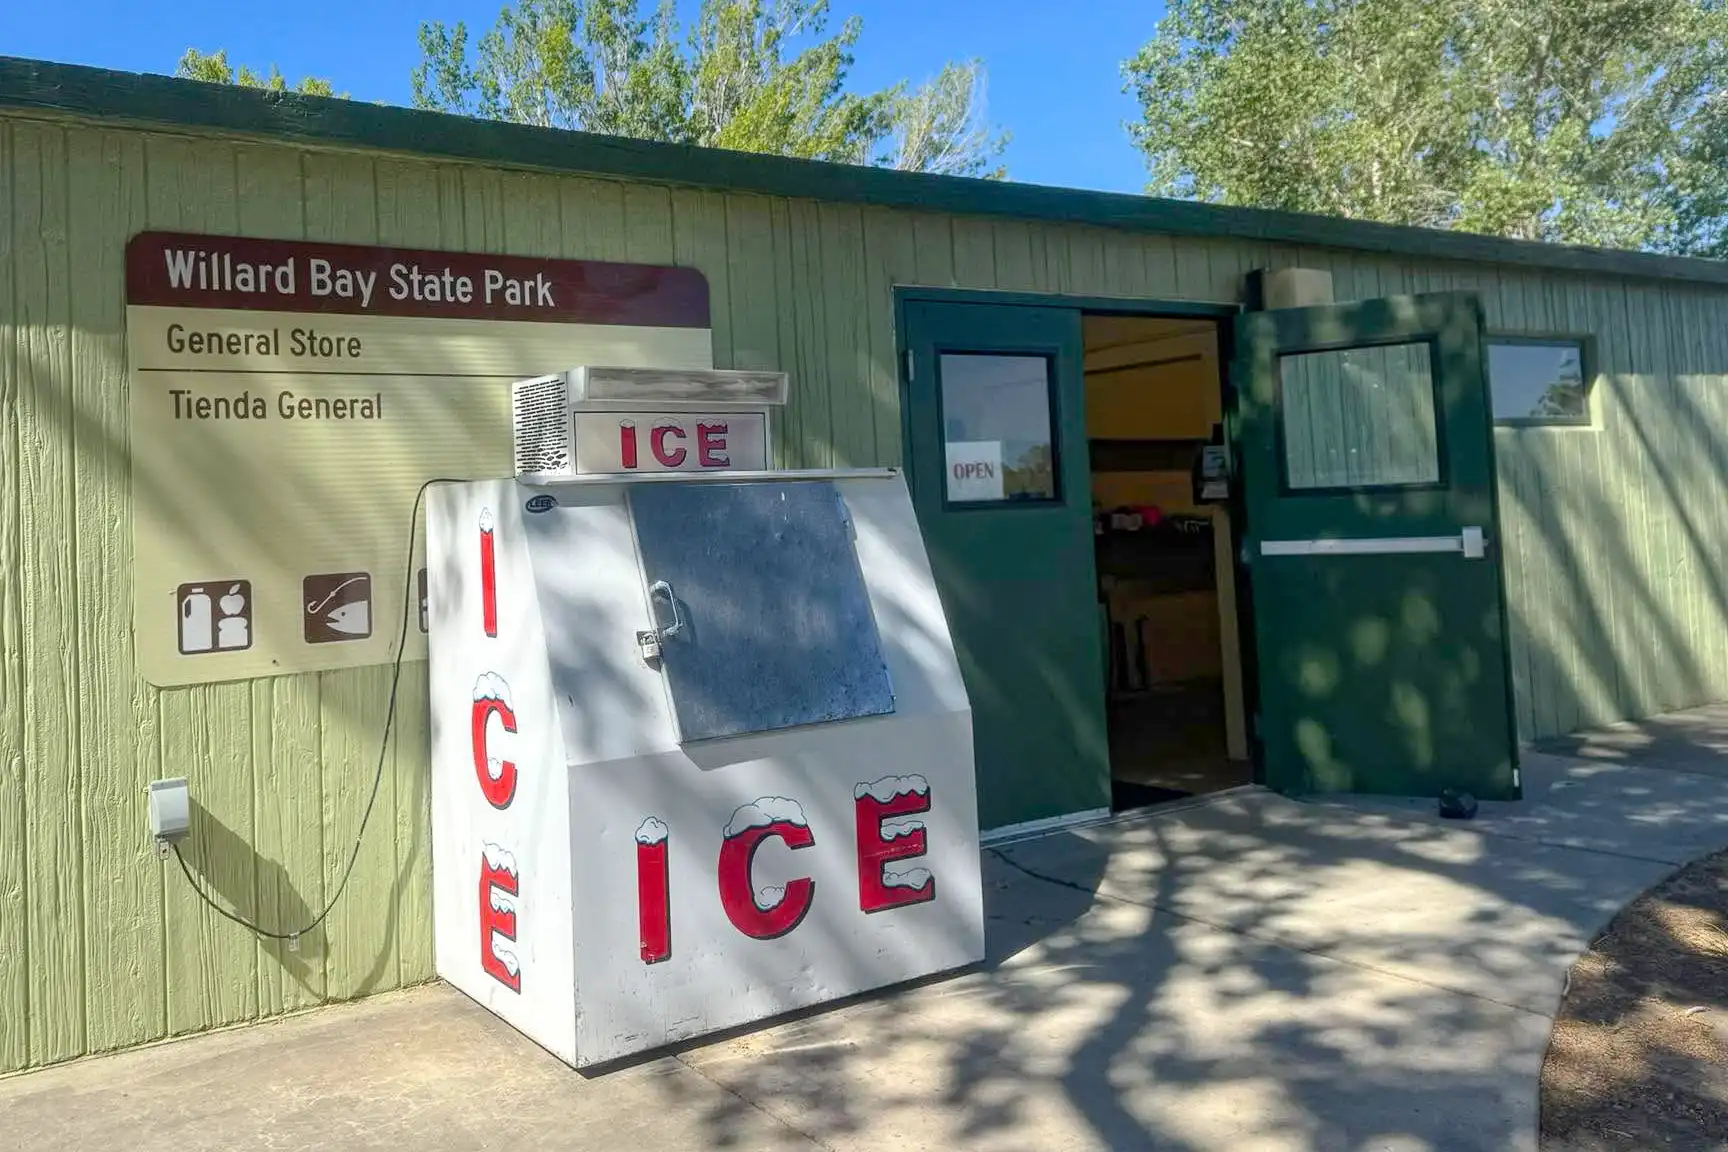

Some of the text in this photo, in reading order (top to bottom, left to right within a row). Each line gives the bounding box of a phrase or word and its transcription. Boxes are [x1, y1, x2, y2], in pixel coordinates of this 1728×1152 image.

[165, 249, 555, 308] Willard Bay State Park
[166, 325, 361, 358] General Store
[169, 390, 382, 420] Tienda General
[619, 417, 732, 469] ICE
[953, 461, 994, 480] OPEN
[472, 507, 521, 994] ICE
[634, 773, 936, 964] ICE
